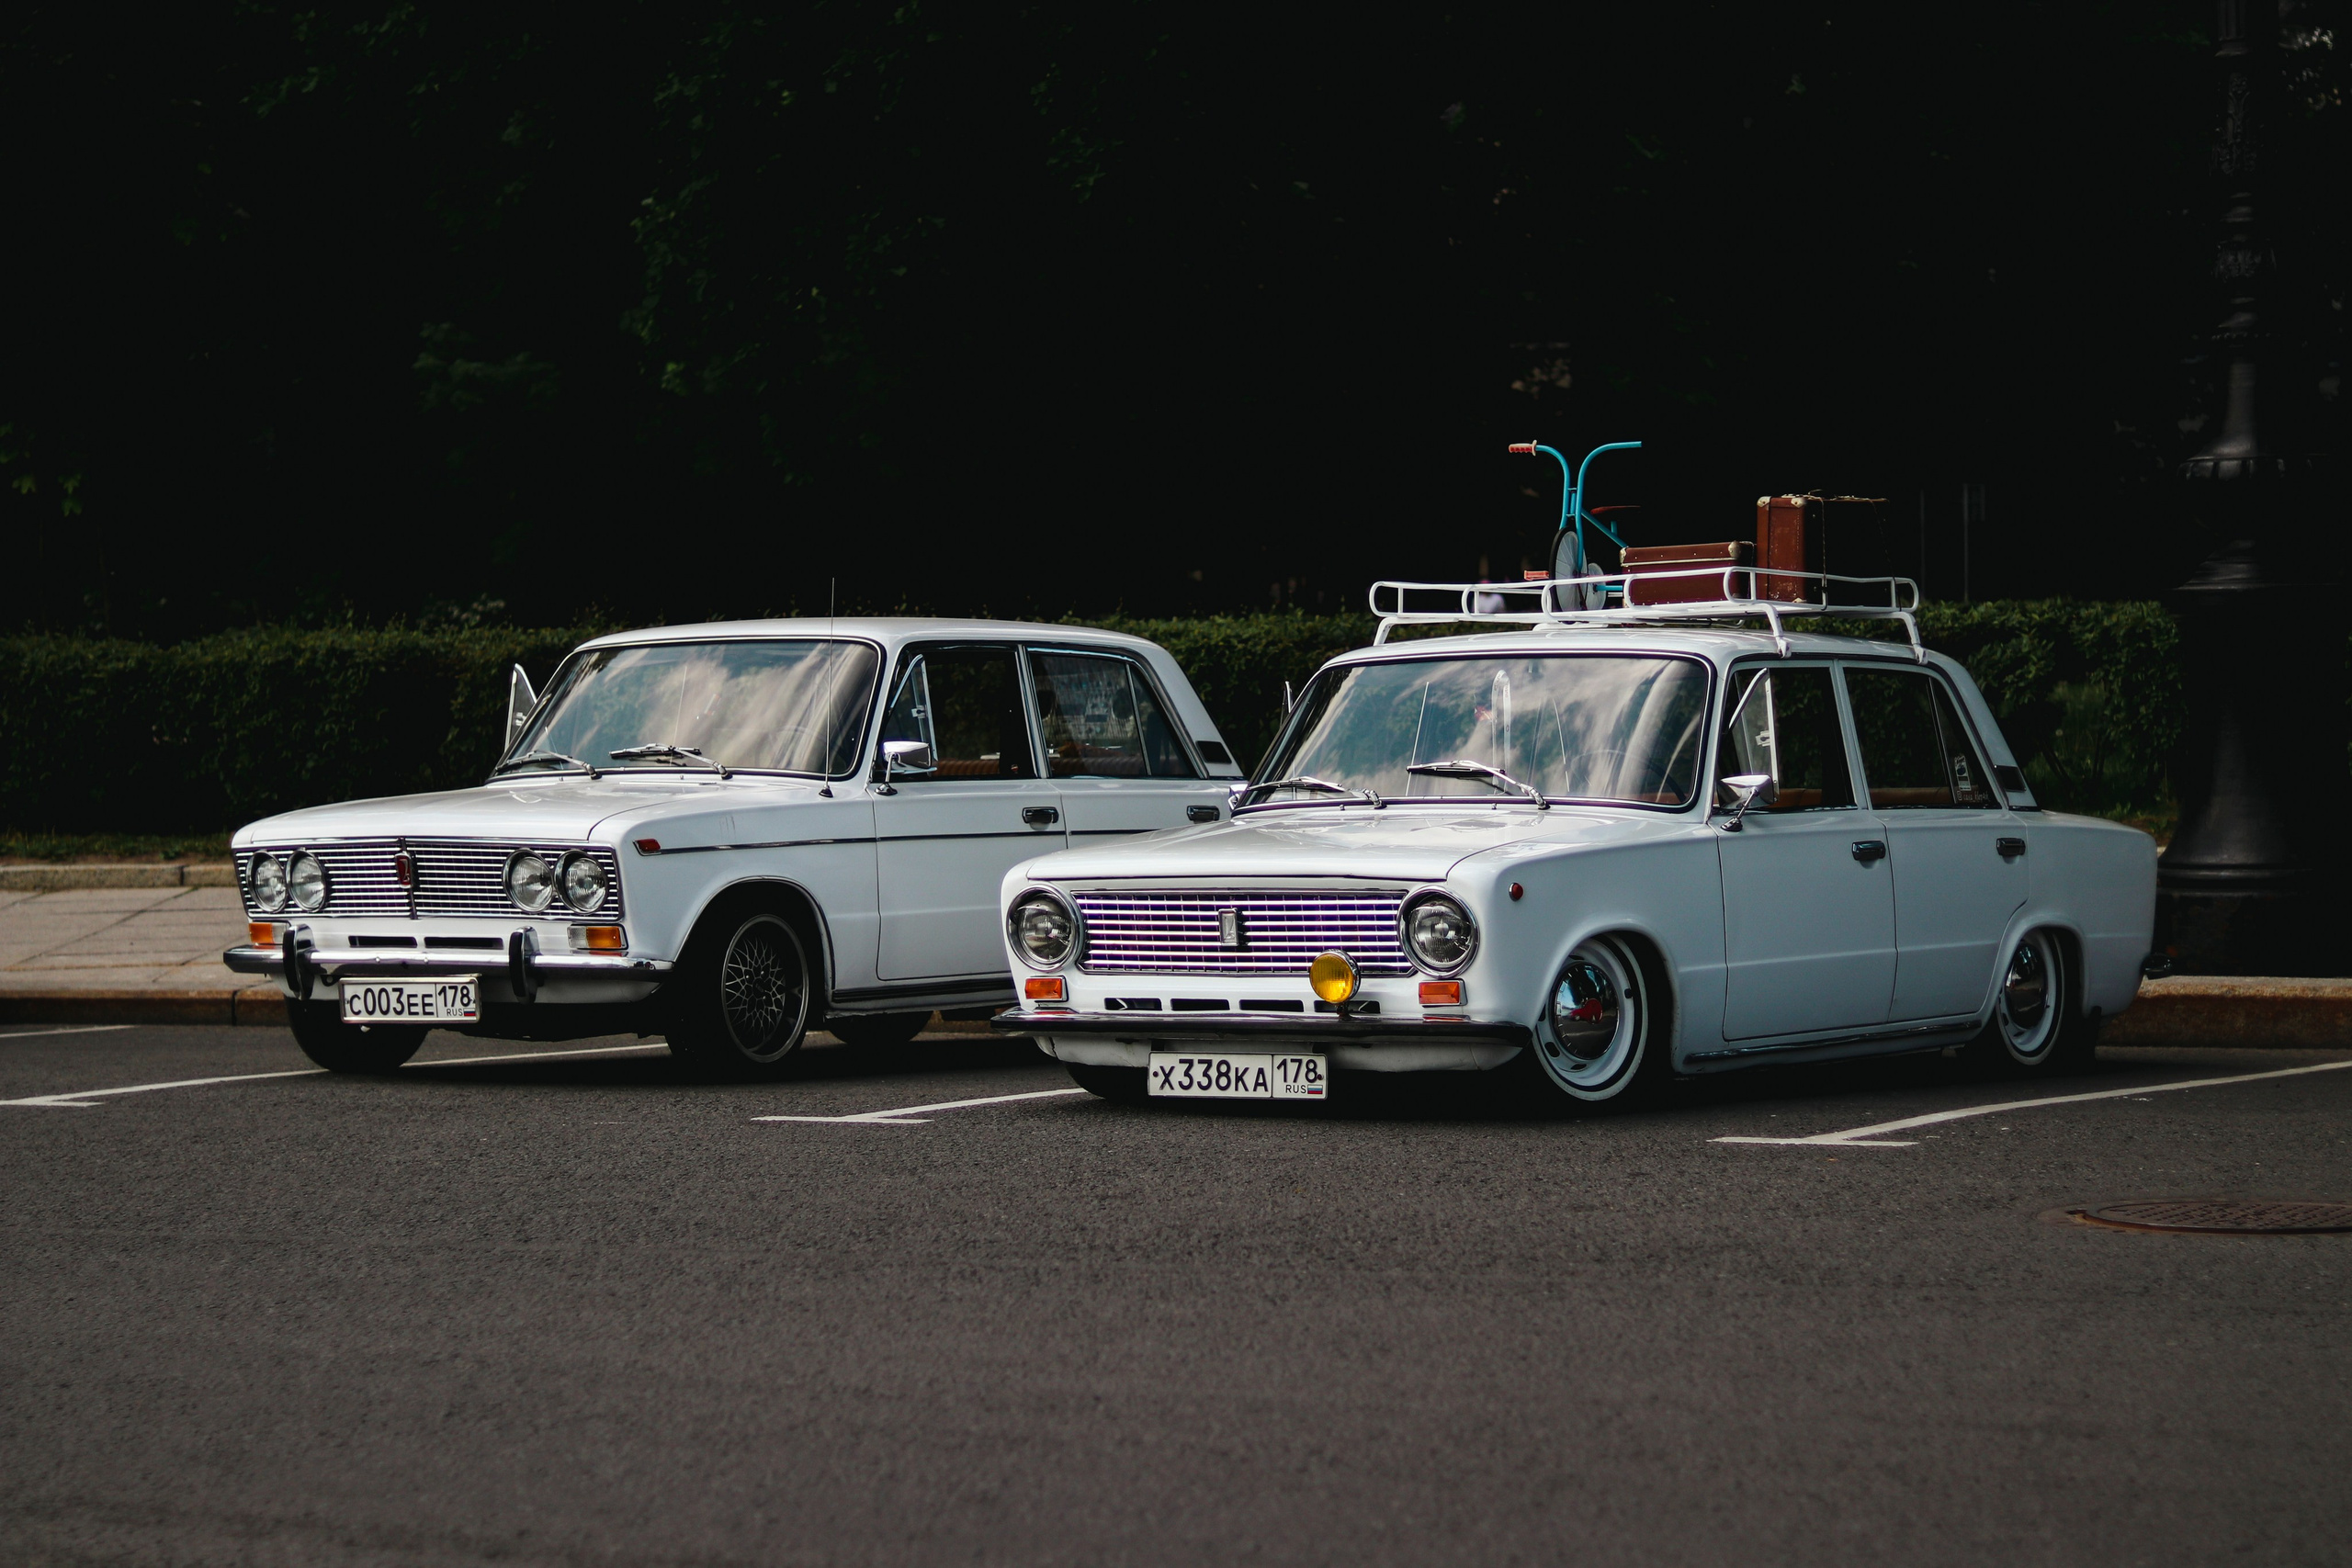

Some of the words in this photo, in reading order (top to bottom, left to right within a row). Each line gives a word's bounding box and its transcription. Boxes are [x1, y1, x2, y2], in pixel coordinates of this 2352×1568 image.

[349, 987, 435, 1016] C003EE
[437, 985, 471, 1008] 178
[446, 1008, 463, 1017] RUS
[1159, 1058, 1269, 1092] X338KA
[1276, 1058, 1317, 1084] 178
[1285, 1084, 1306, 1094] RUS
